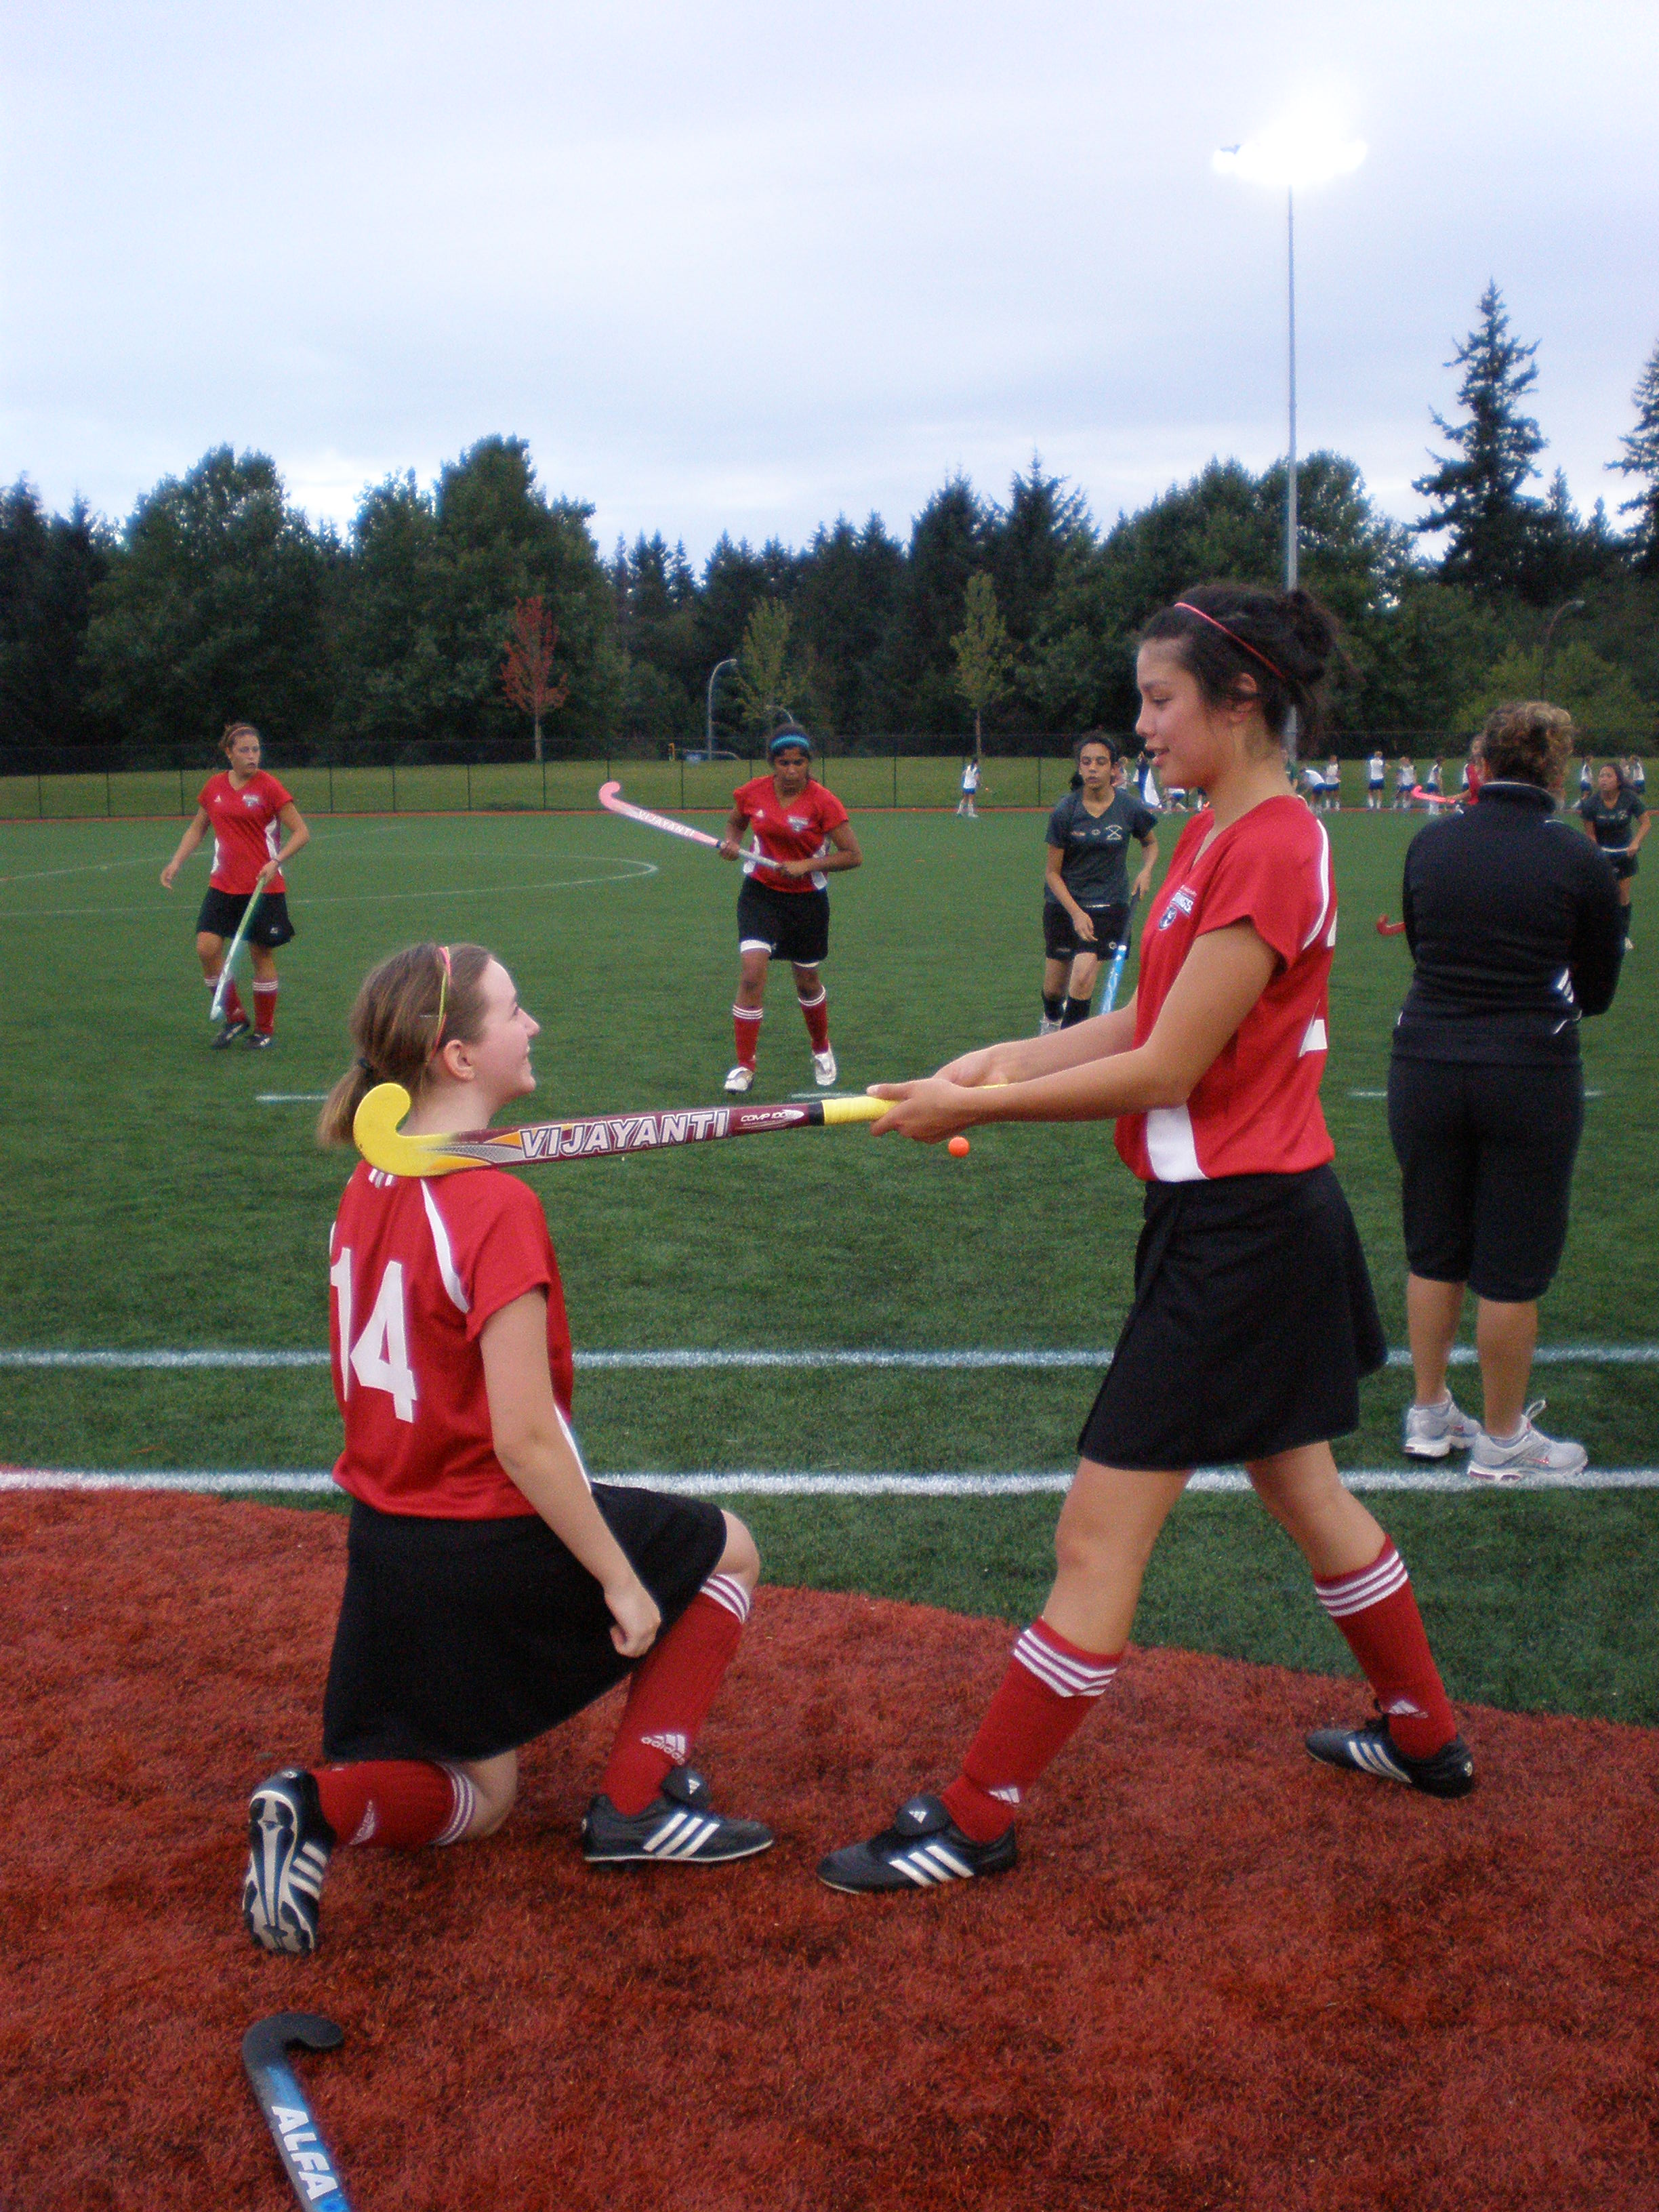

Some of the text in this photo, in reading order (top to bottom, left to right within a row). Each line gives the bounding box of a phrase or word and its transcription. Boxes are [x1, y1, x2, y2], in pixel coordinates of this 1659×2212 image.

[638, 810, 695, 837] VIJAYANTI
[519, 1109, 729, 1159] VIJAYANTI
[741, 1113, 770, 1122] COMP
[330, 1246, 417, 1423] 14
[640, 1736, 685, 1765] adidas
[272, 2106, 338, 2200] ALFA
